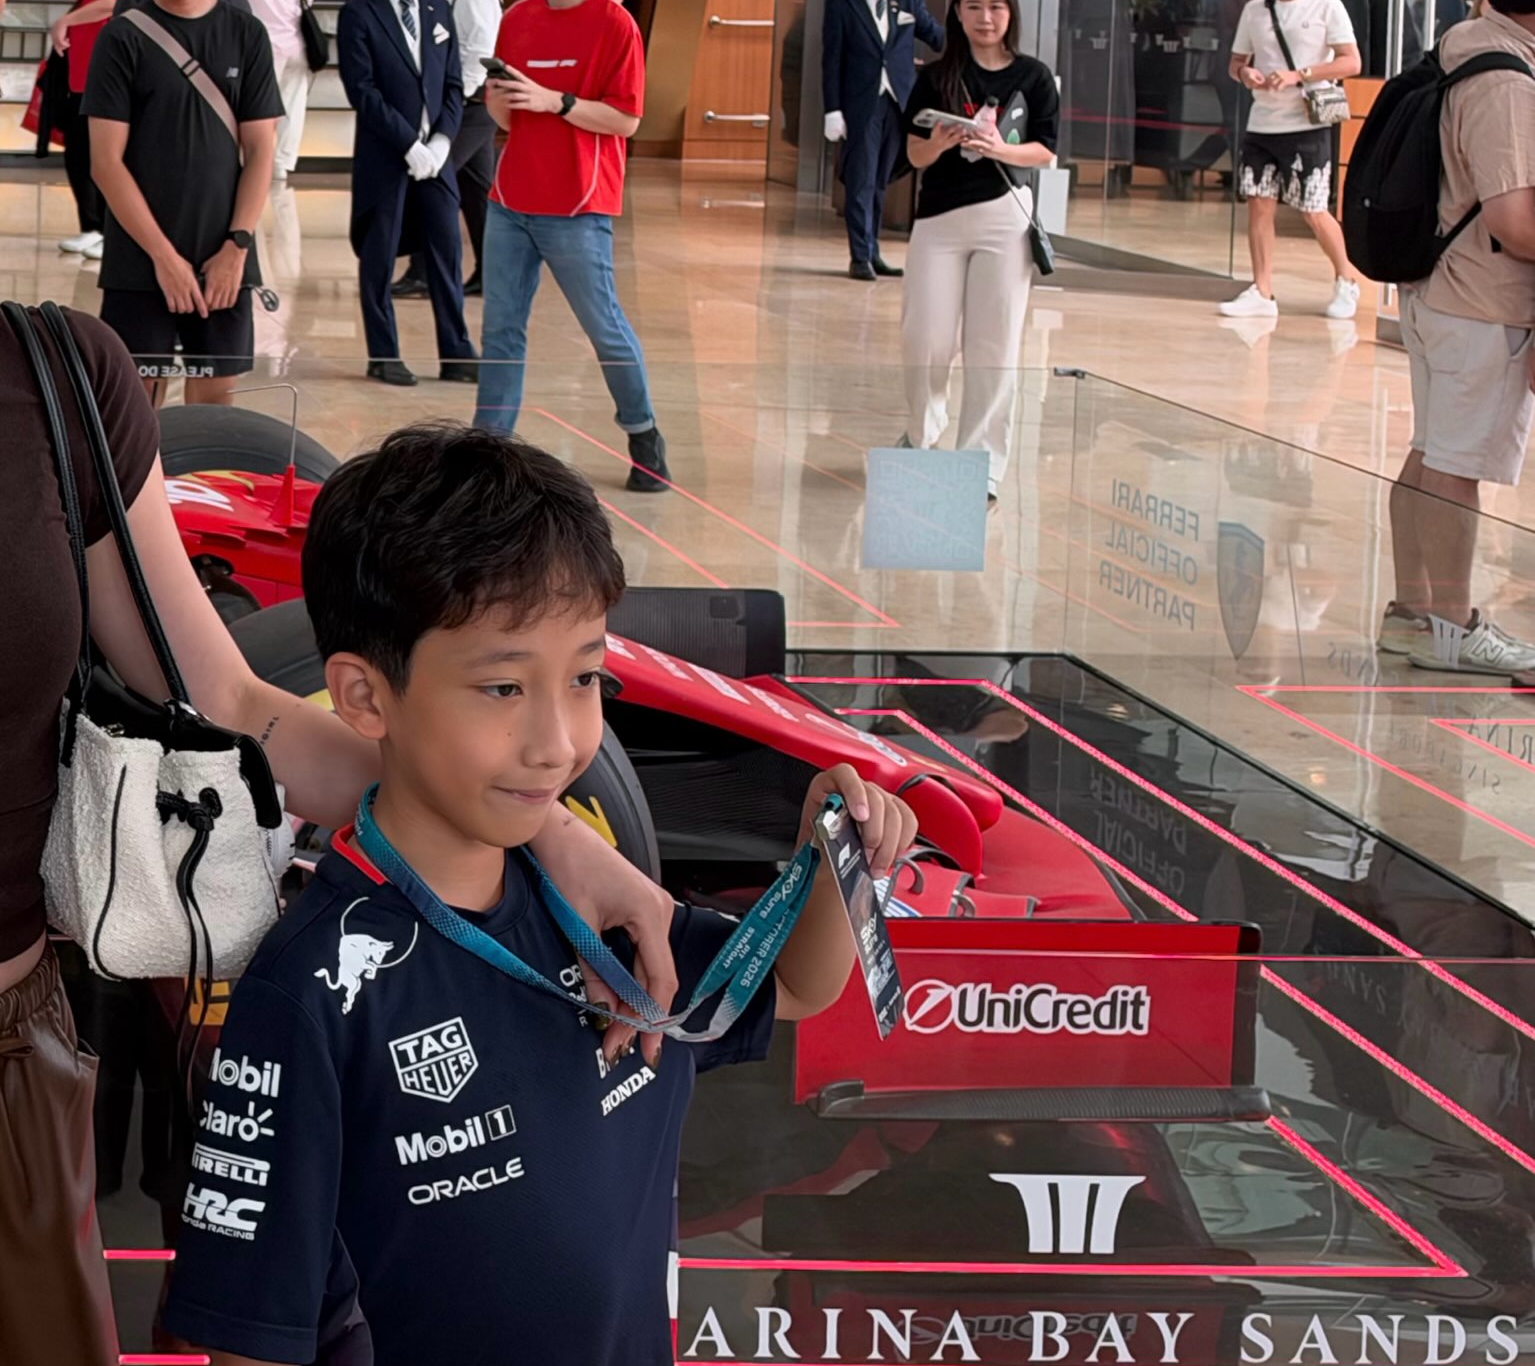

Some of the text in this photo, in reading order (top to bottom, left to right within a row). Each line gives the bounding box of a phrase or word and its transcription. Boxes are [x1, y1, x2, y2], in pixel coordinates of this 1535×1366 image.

[759, 892, 782, 919] SUITE
[723, 927, 755, 969] STRAIGHT
[738, 944, 751, 960] PIT
[740, 953, 763, 988] 2026
[956, 983, 1150, 1033] UniCredit
[398, 1029, 463, 1064] TAG
[402, 1052, 474, 1098] HEUER
[601, 1066, 656, 1116] HONDA
[395, 1115, 486, 1166] Mobil
[408, 1158, 525, 1206] ORACLE
[184, 1182, 266, 1232] HRC
[208, 1224, 255, 1241] RACING
[684, 1306, 1521, 1366] ARINA BAY SANDS
